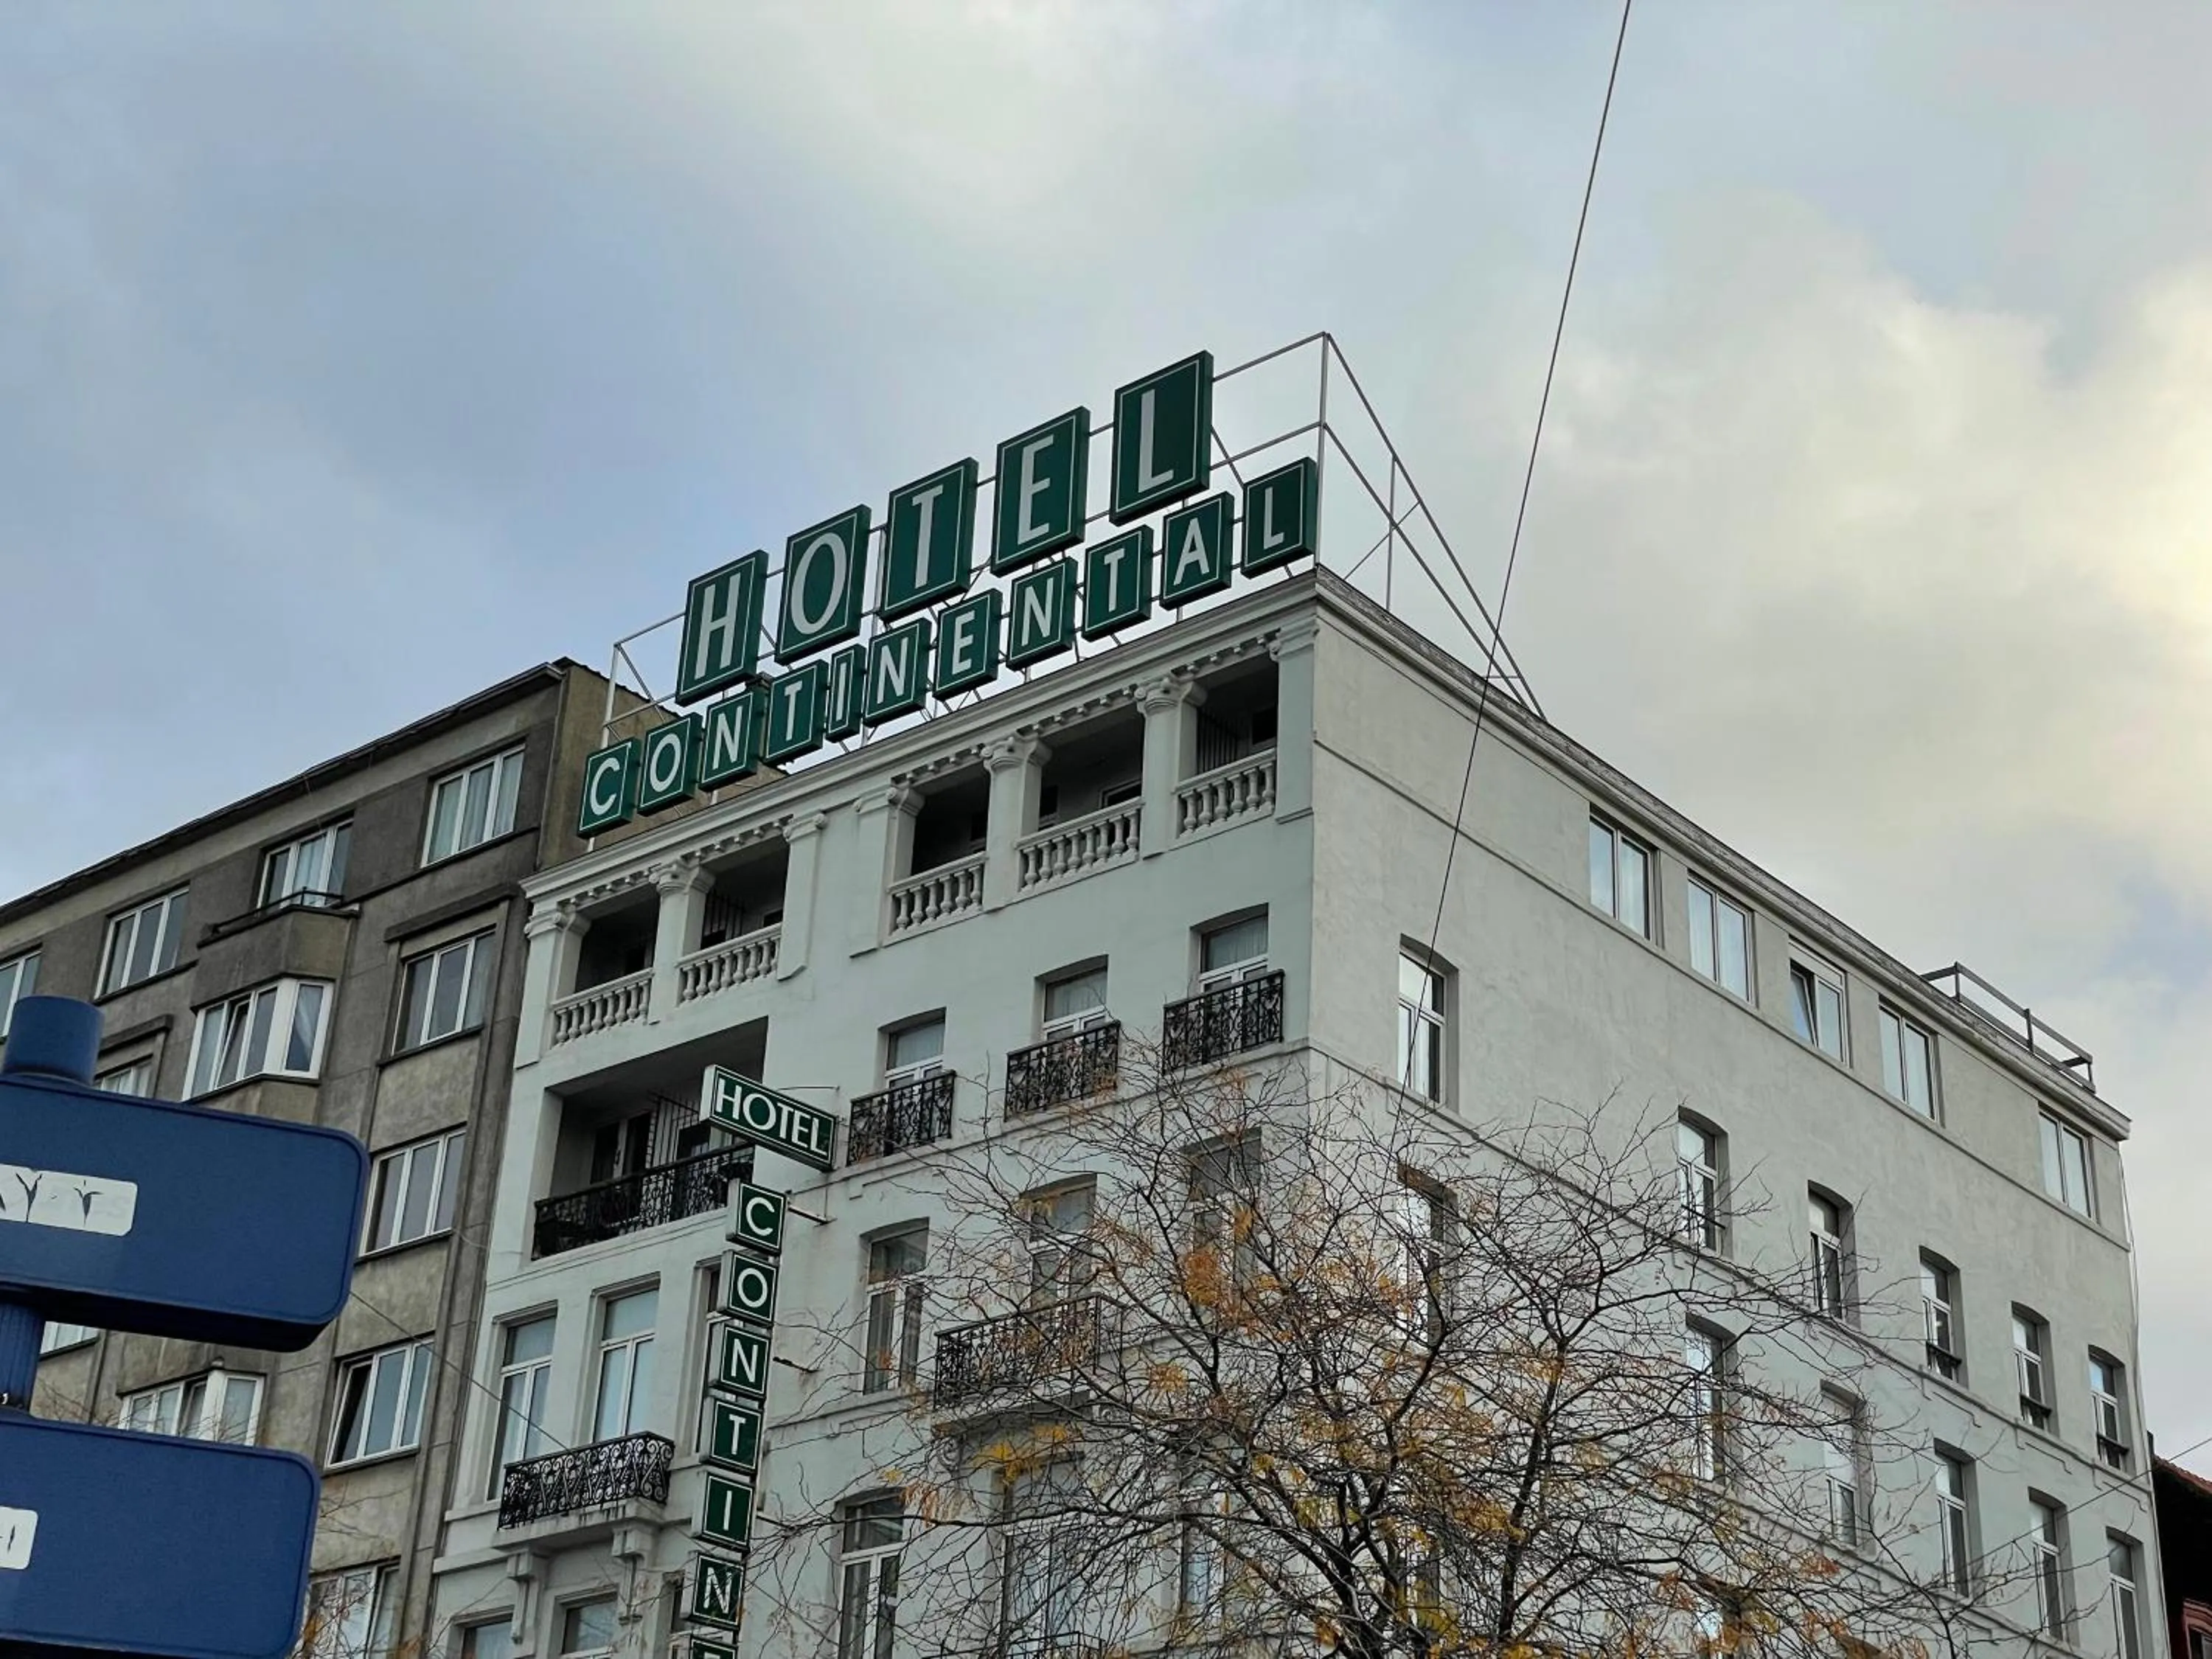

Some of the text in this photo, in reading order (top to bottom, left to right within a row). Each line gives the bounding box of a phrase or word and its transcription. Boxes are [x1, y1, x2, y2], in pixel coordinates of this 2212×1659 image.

[591, 486, 1284, 815] CONTINENTAL
[693, 389, 1175, 680] HOTEL
[715, 1077, 827, 1155] HOTEL
[703, 1196, 775, 1659] CONTIN
